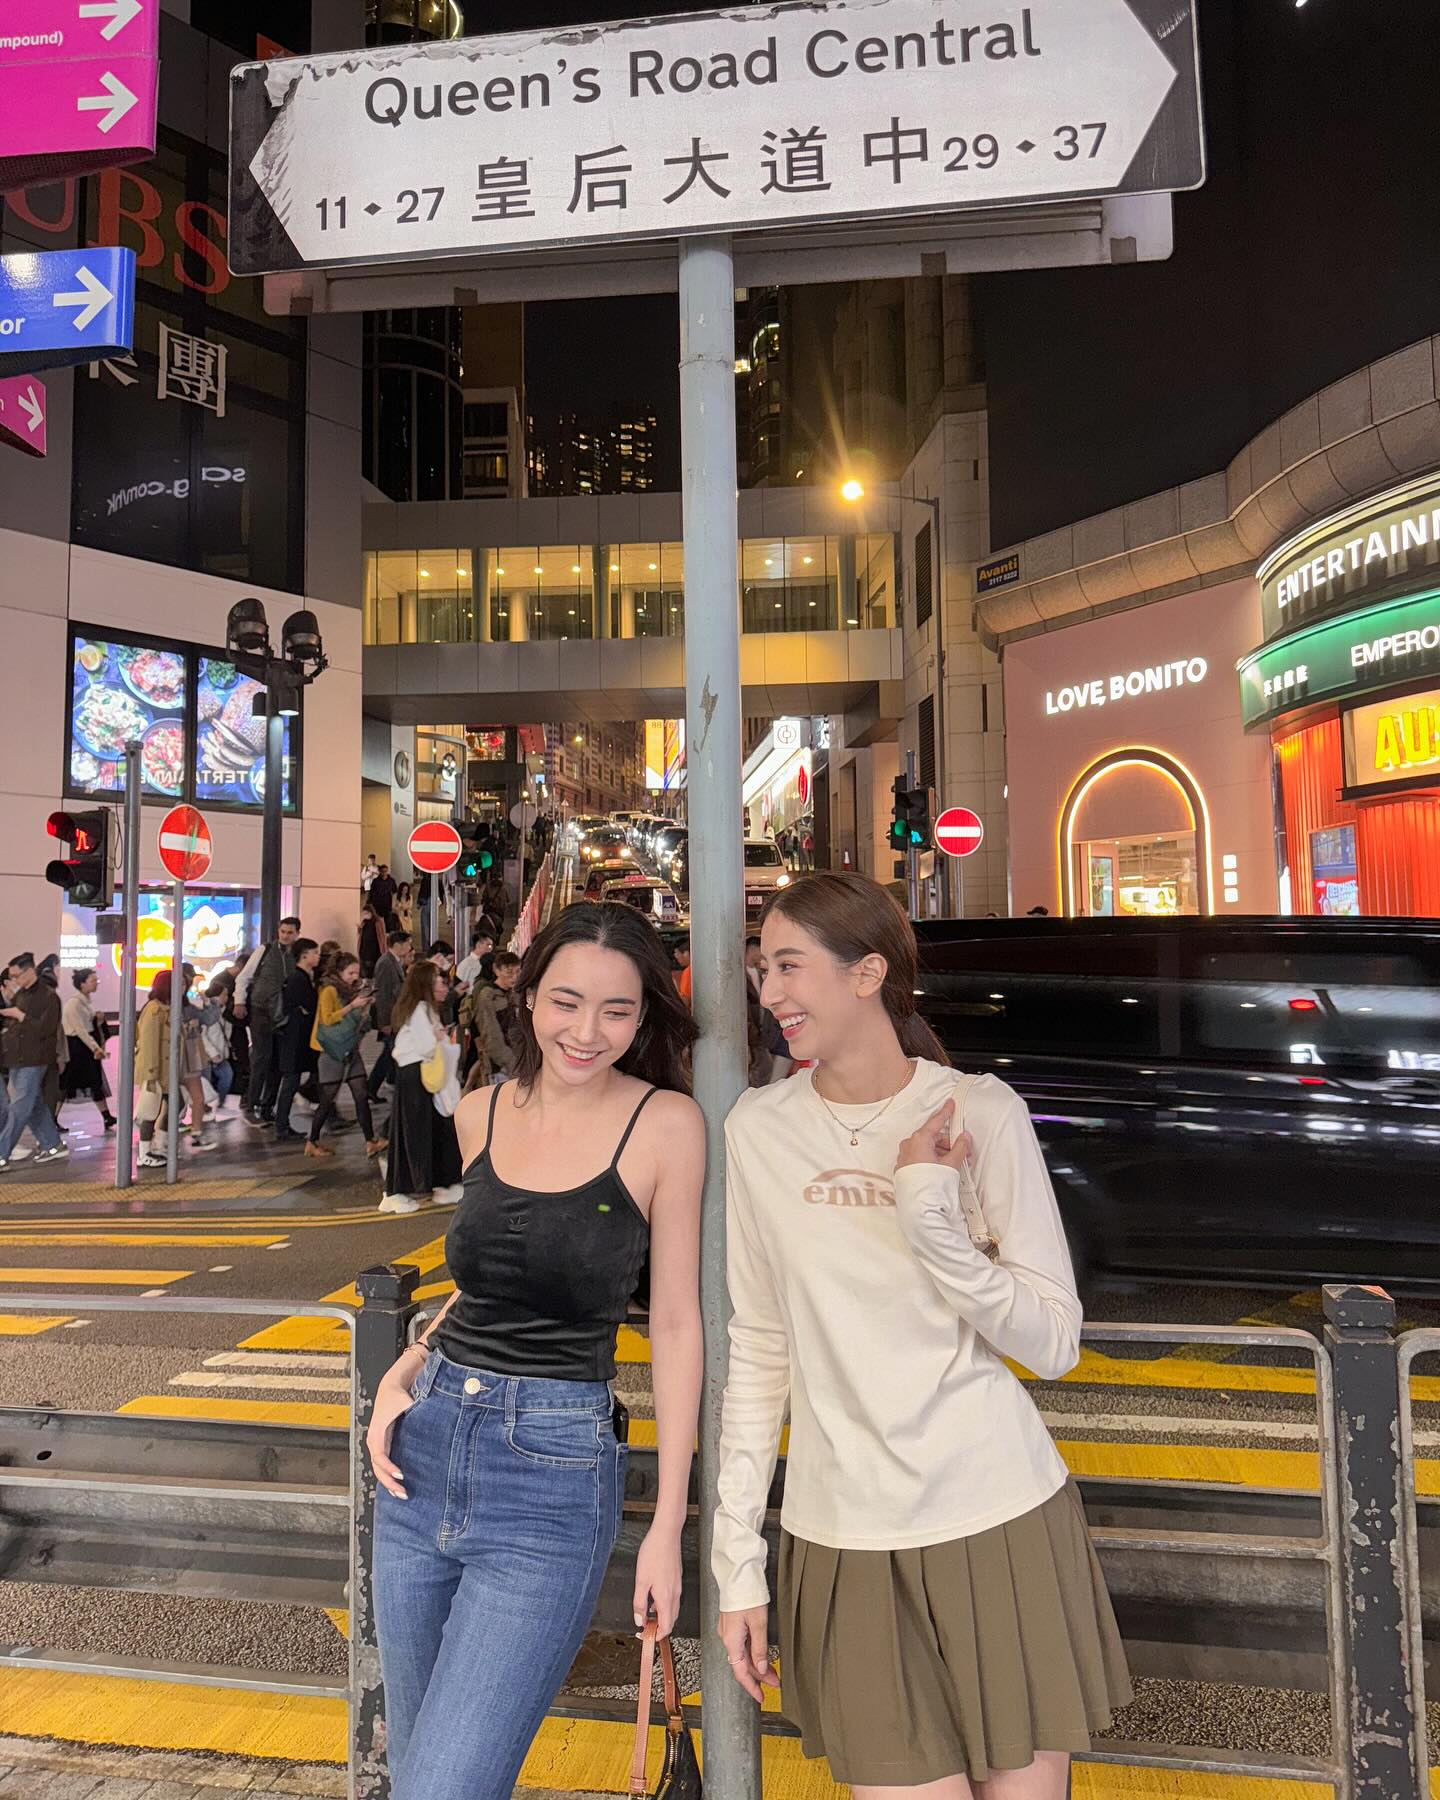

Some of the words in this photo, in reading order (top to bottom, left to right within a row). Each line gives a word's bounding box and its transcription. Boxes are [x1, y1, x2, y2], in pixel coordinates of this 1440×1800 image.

[0, 30, 64, 50] mpound)
[629, 36, 778, 98] Road
[805, 8, 1041, 79] Central
[943, 133, 999, 172] 29
[1053, 122, 1107, 161] 37
[471, 116, 929, 223] 皇后大道中
[316, 196, 346, 231] 11
[397, 187, 445, 224] 27
[0, 318, 26, 335] or
[979, 558, 1018, 581] Avanti
[1351, 625, 1440, 667] EMPERO
[1109, 656, 1207, 701] BONITO
[1375, 705, 1440, 769] AU
[803, 1181, 897, 1207] emis
